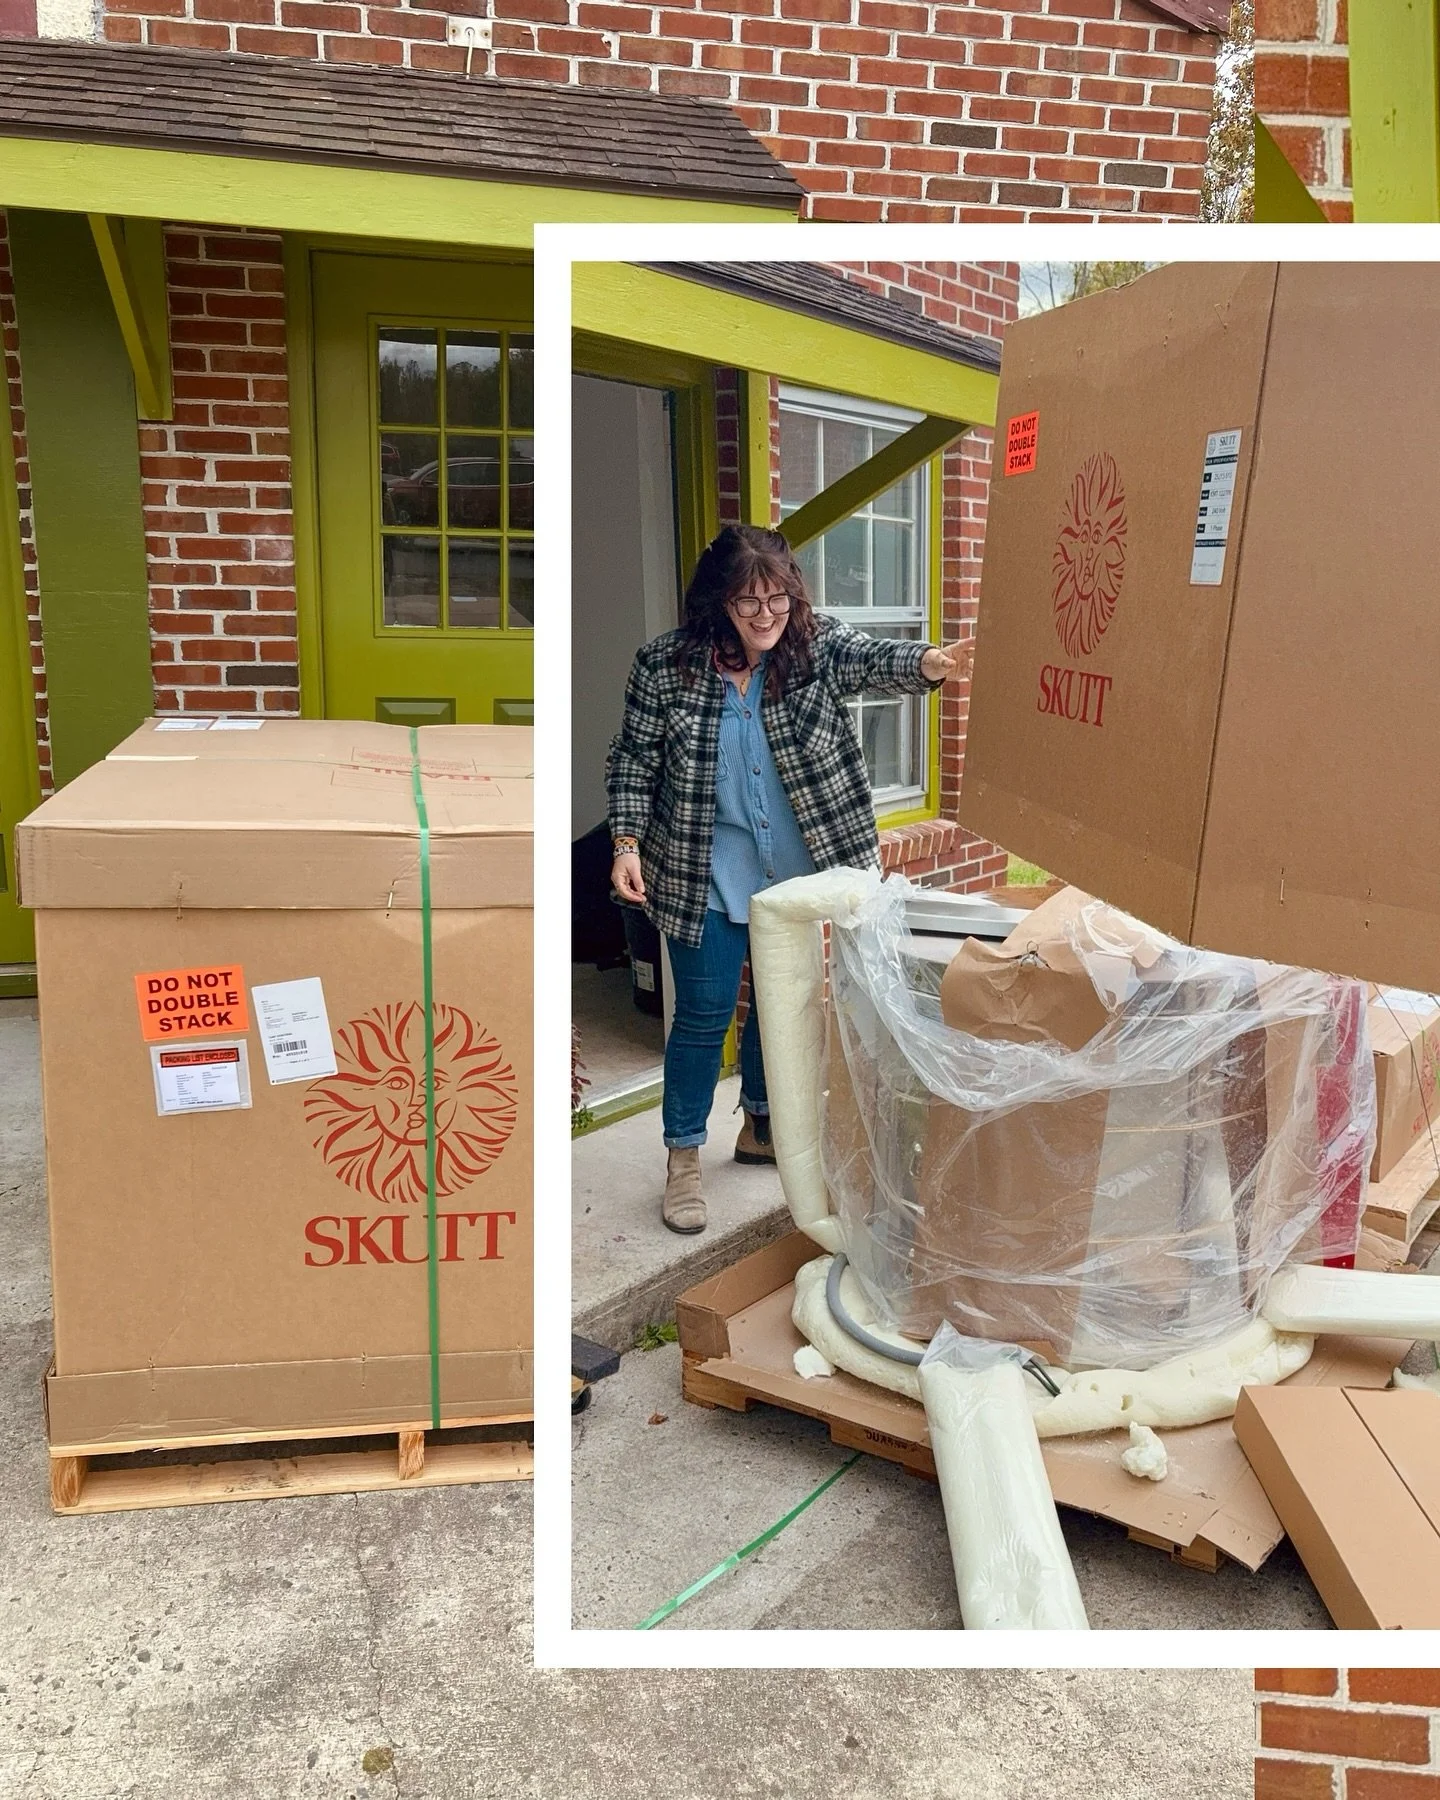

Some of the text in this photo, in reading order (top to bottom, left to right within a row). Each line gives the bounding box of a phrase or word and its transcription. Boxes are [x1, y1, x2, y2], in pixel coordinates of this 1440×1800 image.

[1011, 416, 1037, 436] DO NOT
[1009, 434, 1036, 453] DOUBLE
[1010, 452, 1031, 469] STACK
[1037, 664, 1113, 727] SKUTT
[147, 972, 233, 994] DO NOT
[147, 991, 239, 1014] DOUBLE
[159, 1011, 233, 1032] STACK
[165, 1051, 235, 1064] PACKING LIST ENCLOSED
[304, 1211, 516, 1267] SKUTT
